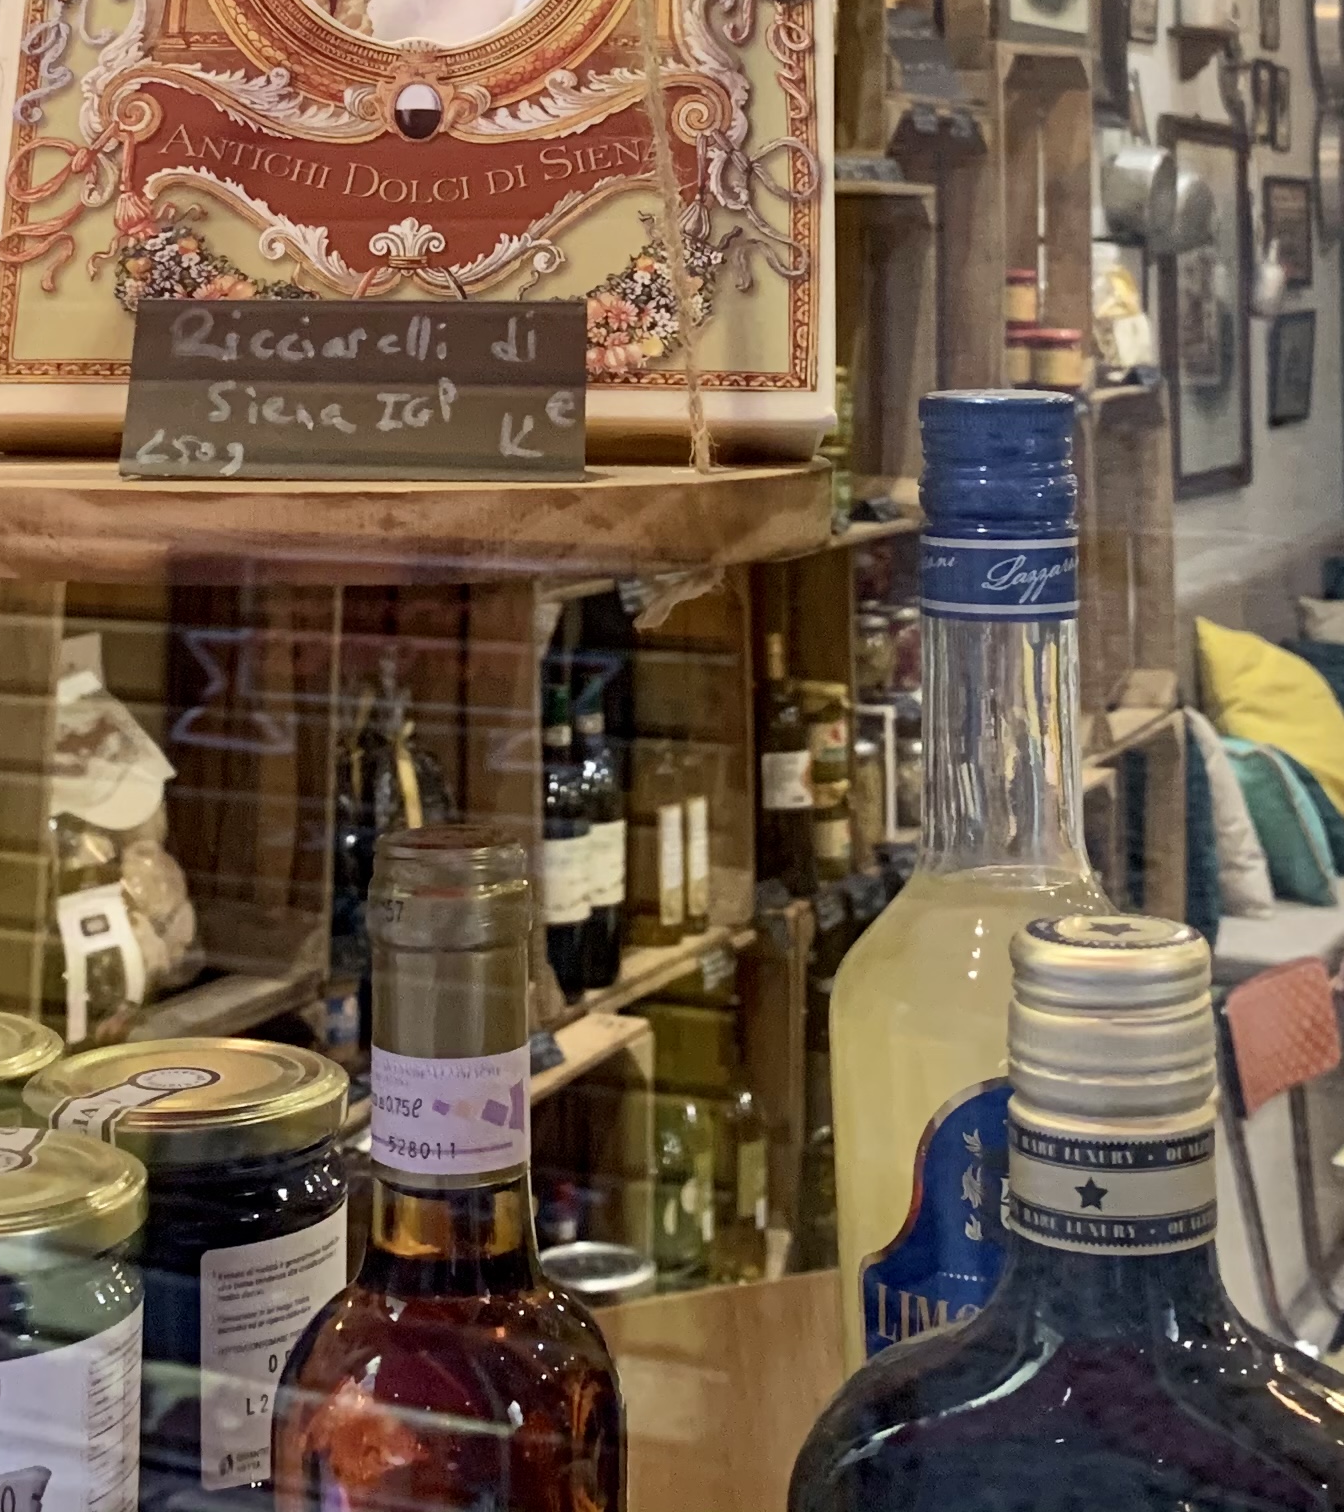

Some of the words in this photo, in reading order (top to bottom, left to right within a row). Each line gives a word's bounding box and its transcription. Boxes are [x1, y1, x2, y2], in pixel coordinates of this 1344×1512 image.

[159, 123, 332, 189] ANTICHI
[343, 162, 469, 203] DOLCI
[485, 163, 528, 194] DI
[171, 307, 447, 362] Ricciarelli
[491, 310, 536, 362] di
[207, 380, 357, 434] Siena
[375, 377, 458, 432] IGP
[1021, 1135, 1057, 1158] RARE
[1063, 1146, 1134, 1165] LUXURY
[1022, 1207, 1057, 1231] RARE
[1065, 1219, 1136, 1239] LUXURY
